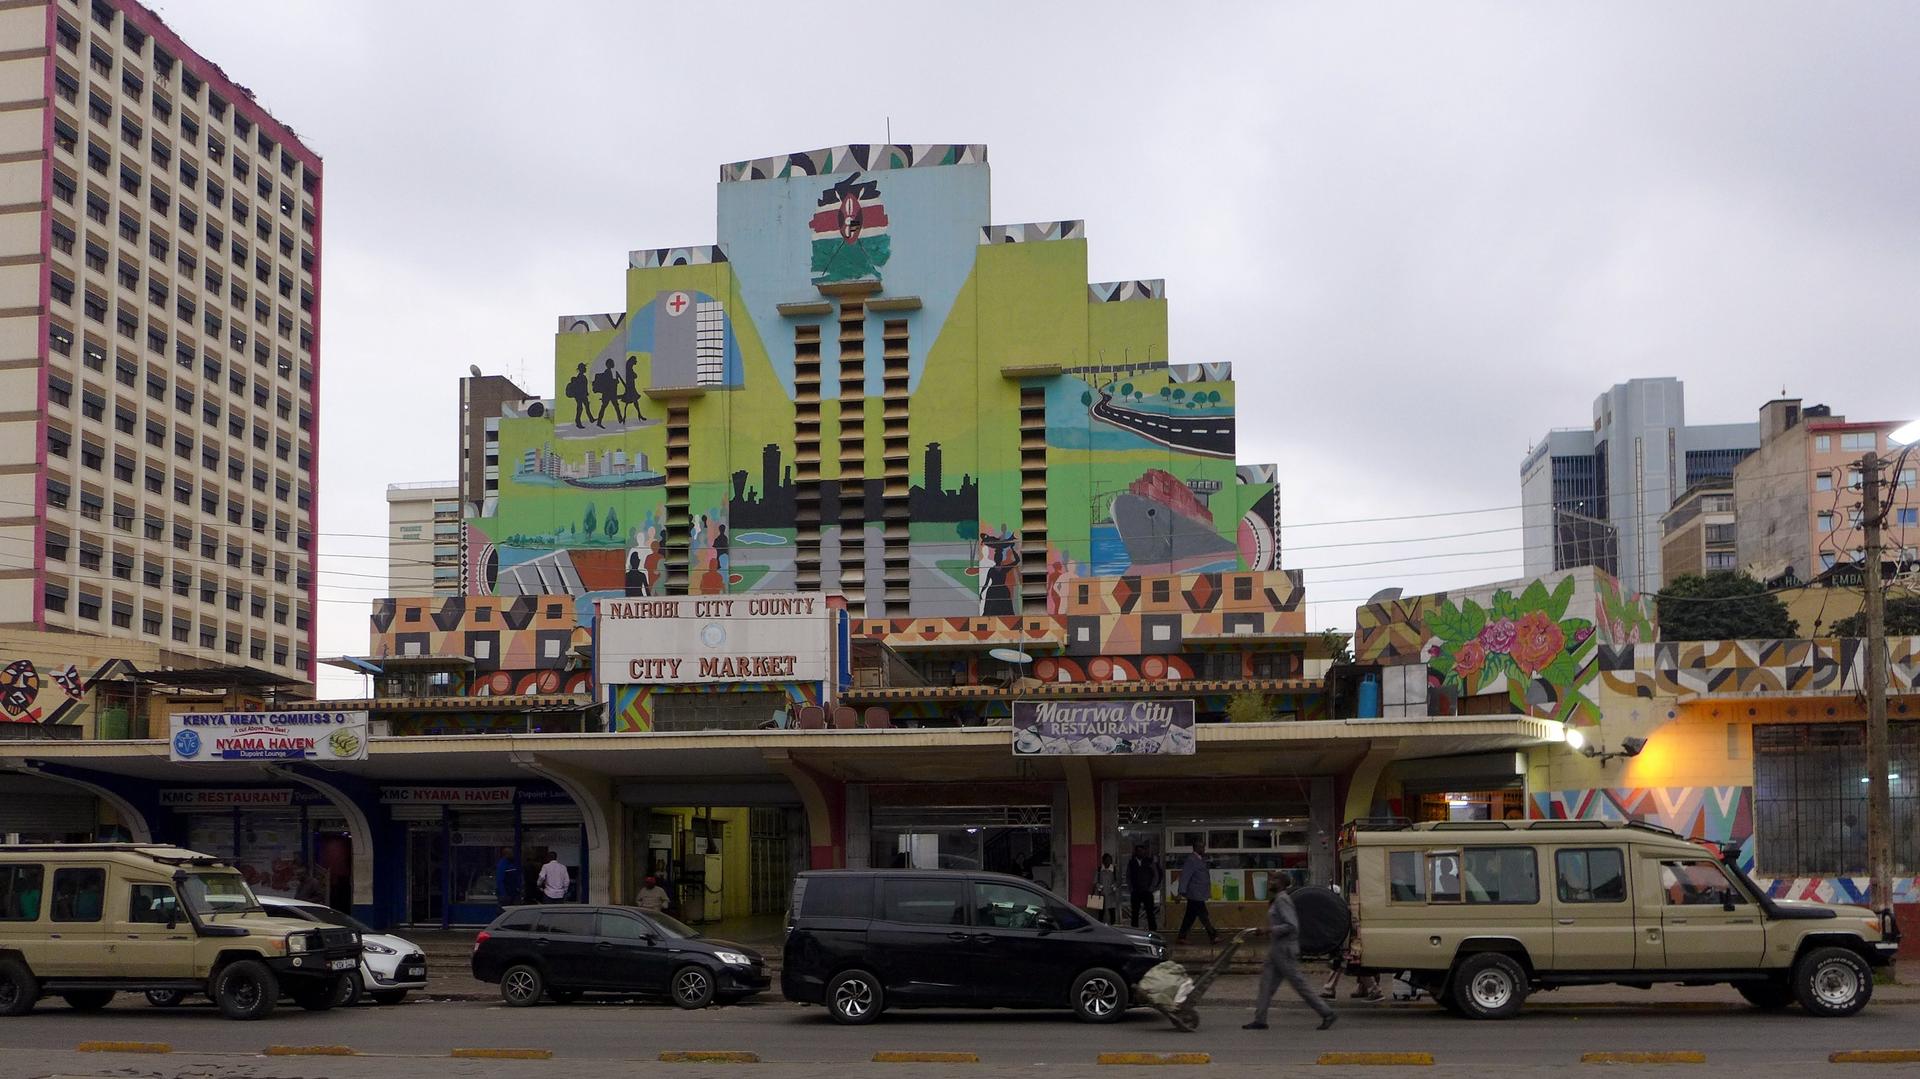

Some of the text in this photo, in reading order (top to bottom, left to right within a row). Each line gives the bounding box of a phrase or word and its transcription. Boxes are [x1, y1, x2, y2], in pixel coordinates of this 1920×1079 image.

[1832, 574, 1866, 586] EMBA
[610, 598, 814, 619] NAIROBI CITY COUNTY
[629, 655, 797, 679] CITY MARKET
[183, 714, 226, 726] KENYA
[230, 714, 265, 725] MEAT
[1036, 702, 1174, 728] Marrwa City
[1051, 722, 1150, 735] RESTAURANT
[216, 738, 314, 750] NYAMA HAVEN
[264, 750, 286, 758] Lounge
[162, 792, 193, 802] KMC
[198, 792, 288, 802] RESTAURANT
[380, 790, 509, 800] KMC NYAMA HAVEN
